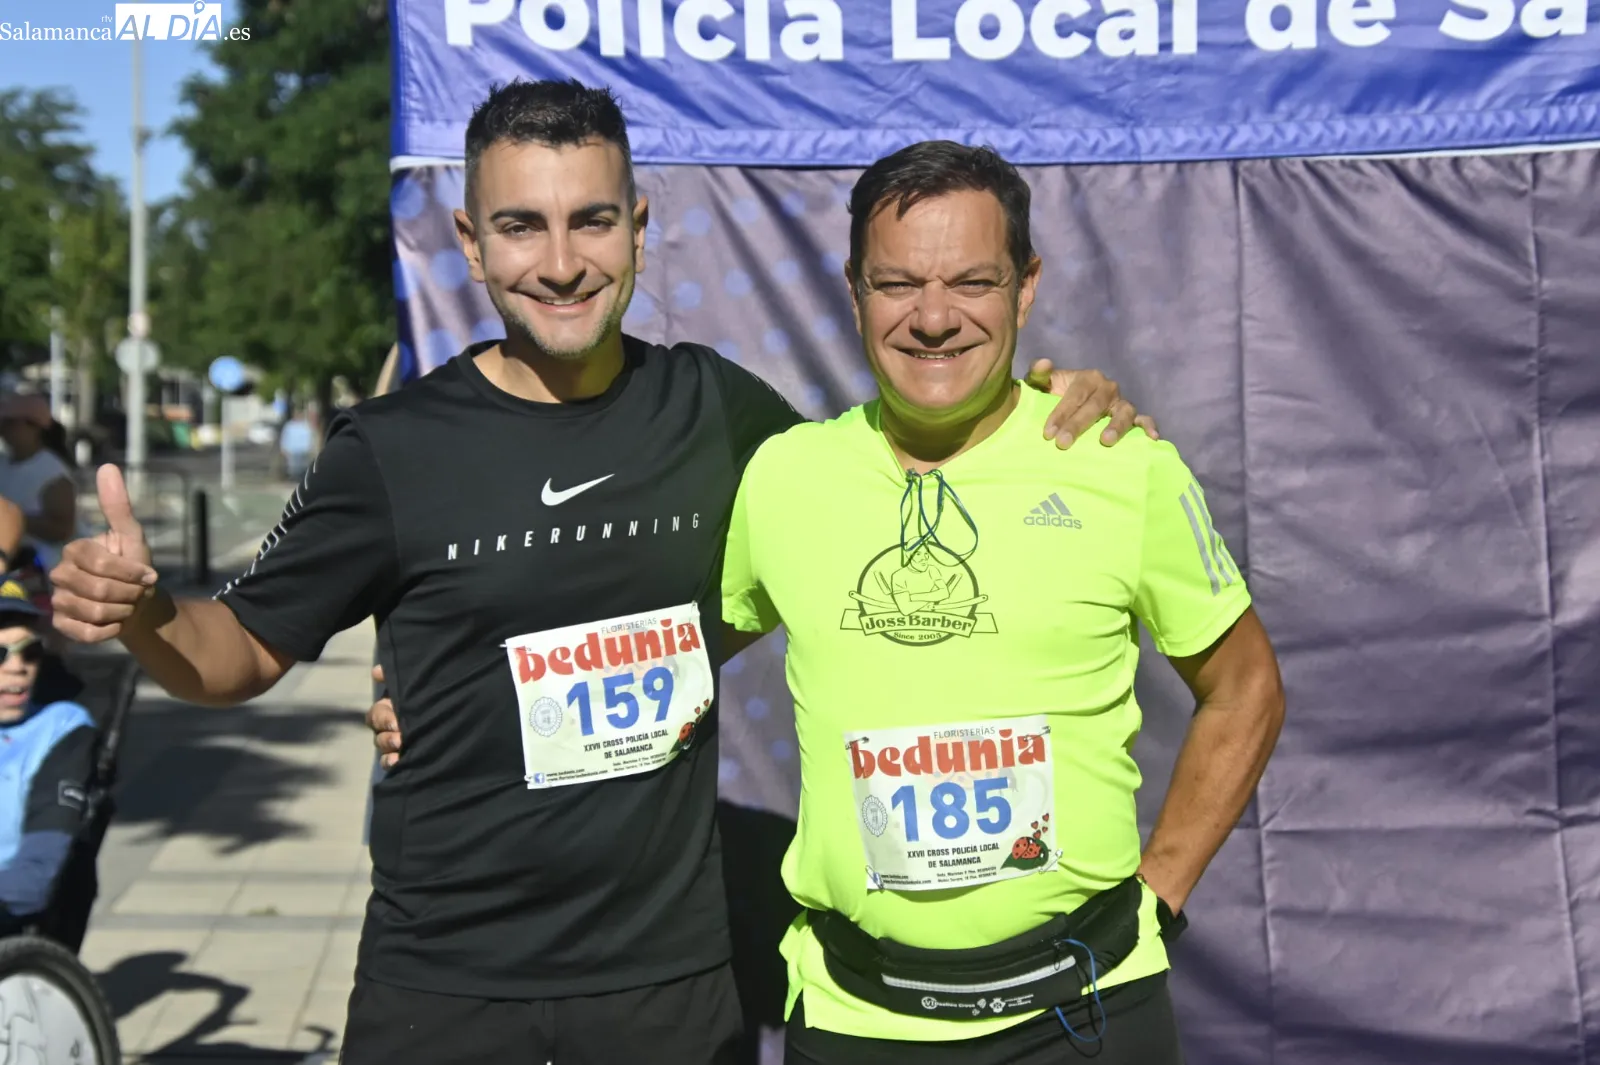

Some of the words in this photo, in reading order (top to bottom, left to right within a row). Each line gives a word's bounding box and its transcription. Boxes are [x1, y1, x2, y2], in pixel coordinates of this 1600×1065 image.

[892, 0, 1198, 61] Local
[1245, 0, 1396, 51] de
[1023, 513, 1083, 530] adidas
[865, 616, 906, 630] Joss
[908, 615, 972, 631] Barber
[894, 632, 915, 641] Since
[513, 618, 701, 685] bedunia
[566, 666, 674, 737] 159
[583, 742, 601, 752] XXVII
[602, 738, 624, 748] CROSS
[650, 729, 669, 739] LOCAL
[933, 726, 996, 739] FLORISTERÍAS
[604, 751, 613, 759] DE
[614, 743, 653, 757] SALAMANCA
[850, 729, 1046, 780] bedunia
[891, 776, 1012, 843] 185
[907, 850, 925, 859] XXVII
[927, 848, 950, 857] CROSS
[952, 844, 978, 855] POLICÍA
[980, 842, 1000, 852] LOCAL
[928, 860, 937, 868] DE
[939, 856, 982, 868] SALAMANCA
